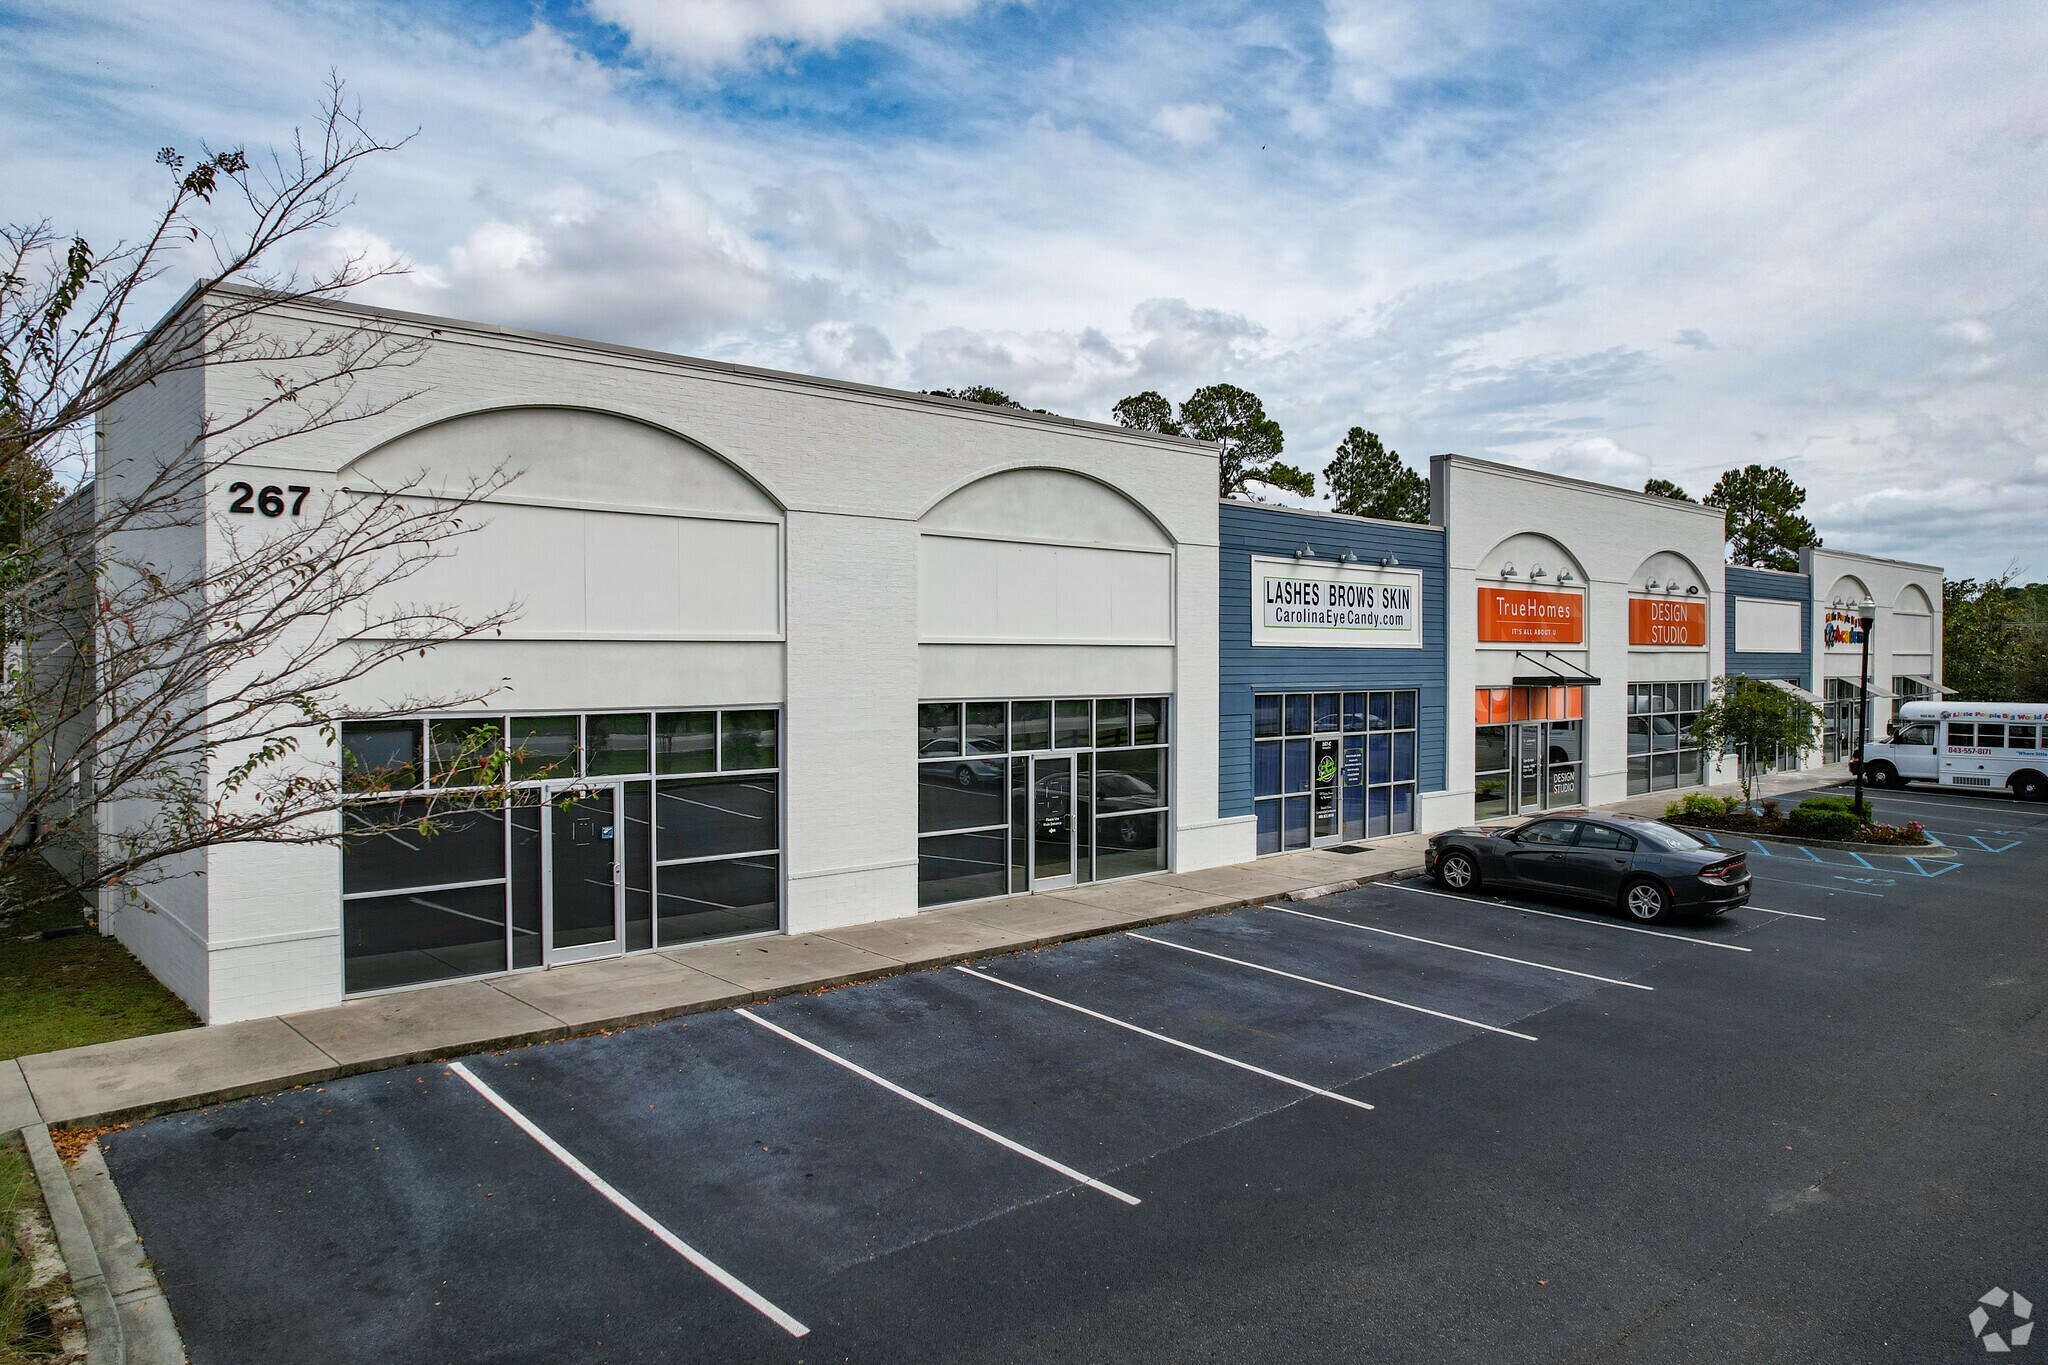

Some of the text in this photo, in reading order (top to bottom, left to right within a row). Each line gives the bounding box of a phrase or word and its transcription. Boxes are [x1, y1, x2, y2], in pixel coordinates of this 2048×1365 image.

[229, 481, 311, 517] 267
[1266, 580, 1410, 610] LASHES BROWS SKIN
[1496, 596, 1570, 618] TrueHomes
[1651, 602, 1688, 622] DESIGN
[1275, 607, 1404, 628] CarolinaEyeCandy.com
[1523, 628, 1532, 636] ALL
[1651, 625, 1688, 644] STUDIO
[1834, 624, 1864, 644] Academ
[1553, 771, 1575, 783] DESIGN
[1553, 782, 1575, 794] STUDIO
